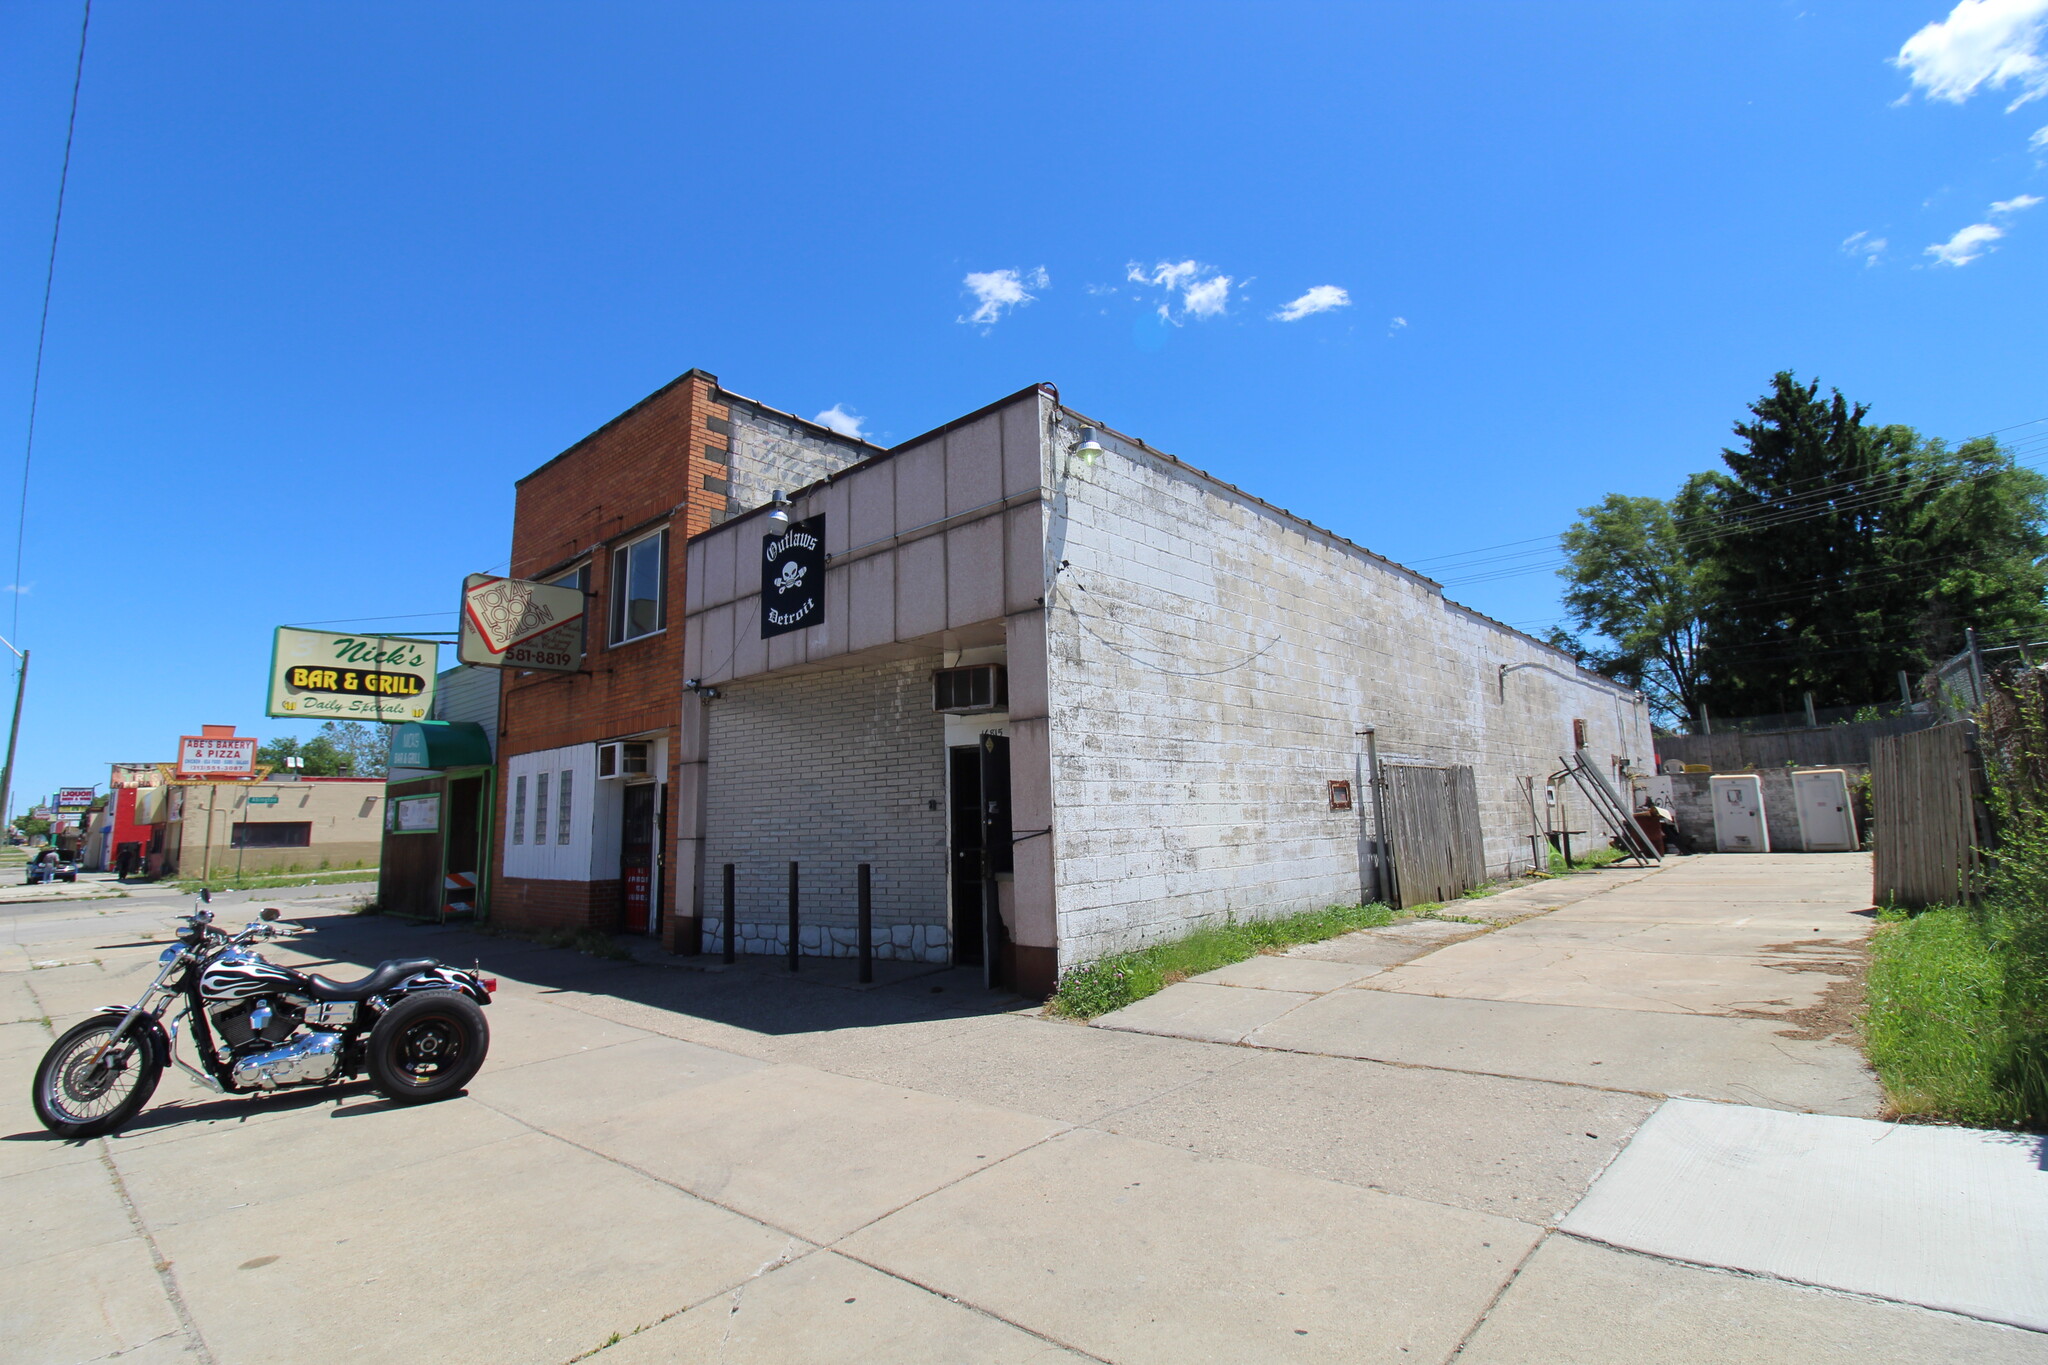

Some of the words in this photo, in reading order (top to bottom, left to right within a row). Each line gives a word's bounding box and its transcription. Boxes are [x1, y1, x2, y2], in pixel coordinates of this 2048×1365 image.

[766, 529, 819, 562] Outlaws
[473, 580, 533, 611] TOTAL
[481, 593, 539, 628] LOOK
[491, 604, 554, 643] SALON
[768, 597, 815, 626] Detroit
[333, 638, 425, 667] Nick's
[505, 648, 571, 666] 581-8819
[293, 668, 338, 691] BAR
[343, 672, 359, 691] &
[364, 674, 420, 695] GRILL
[303, 697, 343, 713] Daily
[348, 701, 405, 714] Specials
[187, 740, 213, 749] ABE'S
[216, 740, 251, 749] BAKERY
[195, 750, 203, 758] &
[208, 750, 241, 758] PIZZA
